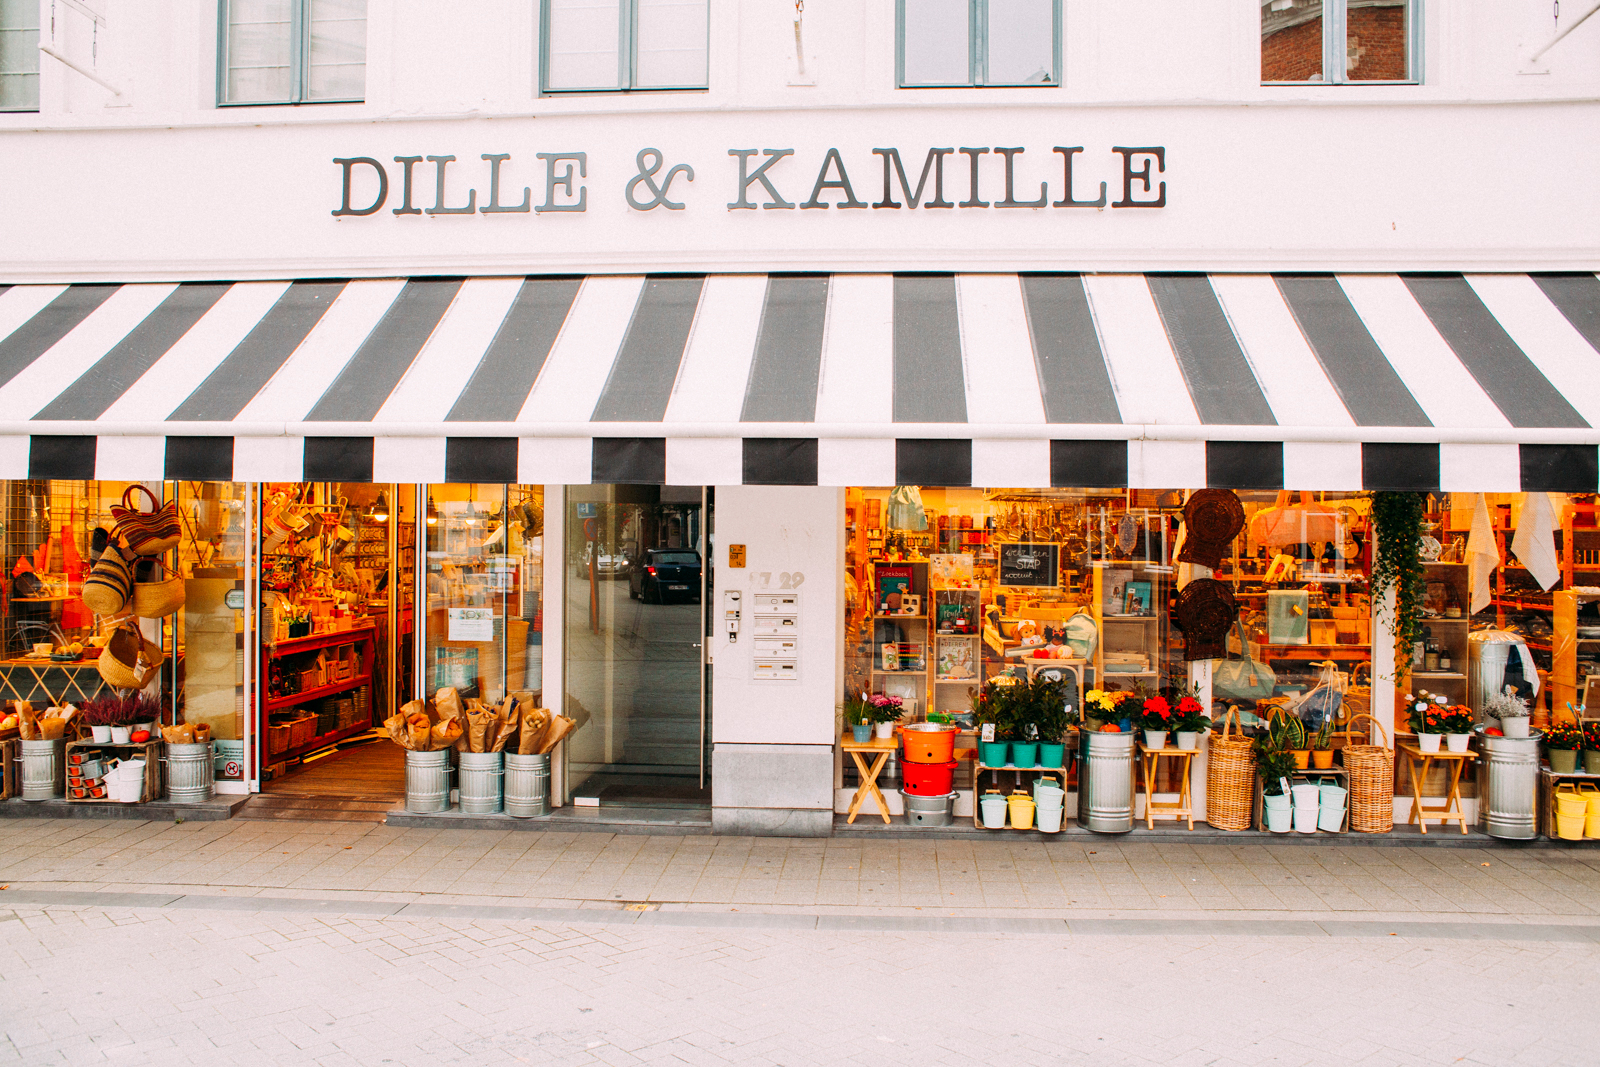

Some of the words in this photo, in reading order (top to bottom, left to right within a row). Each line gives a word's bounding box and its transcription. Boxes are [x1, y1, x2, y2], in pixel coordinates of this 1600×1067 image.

[332, 151, 588, 216] DILLE
[625, 148, 694, 209] &
[728, 147, 1166, 209] KAMILLE
[1016, 559, 1040, 569] STAP
[779, 571, 805, 589] 29
